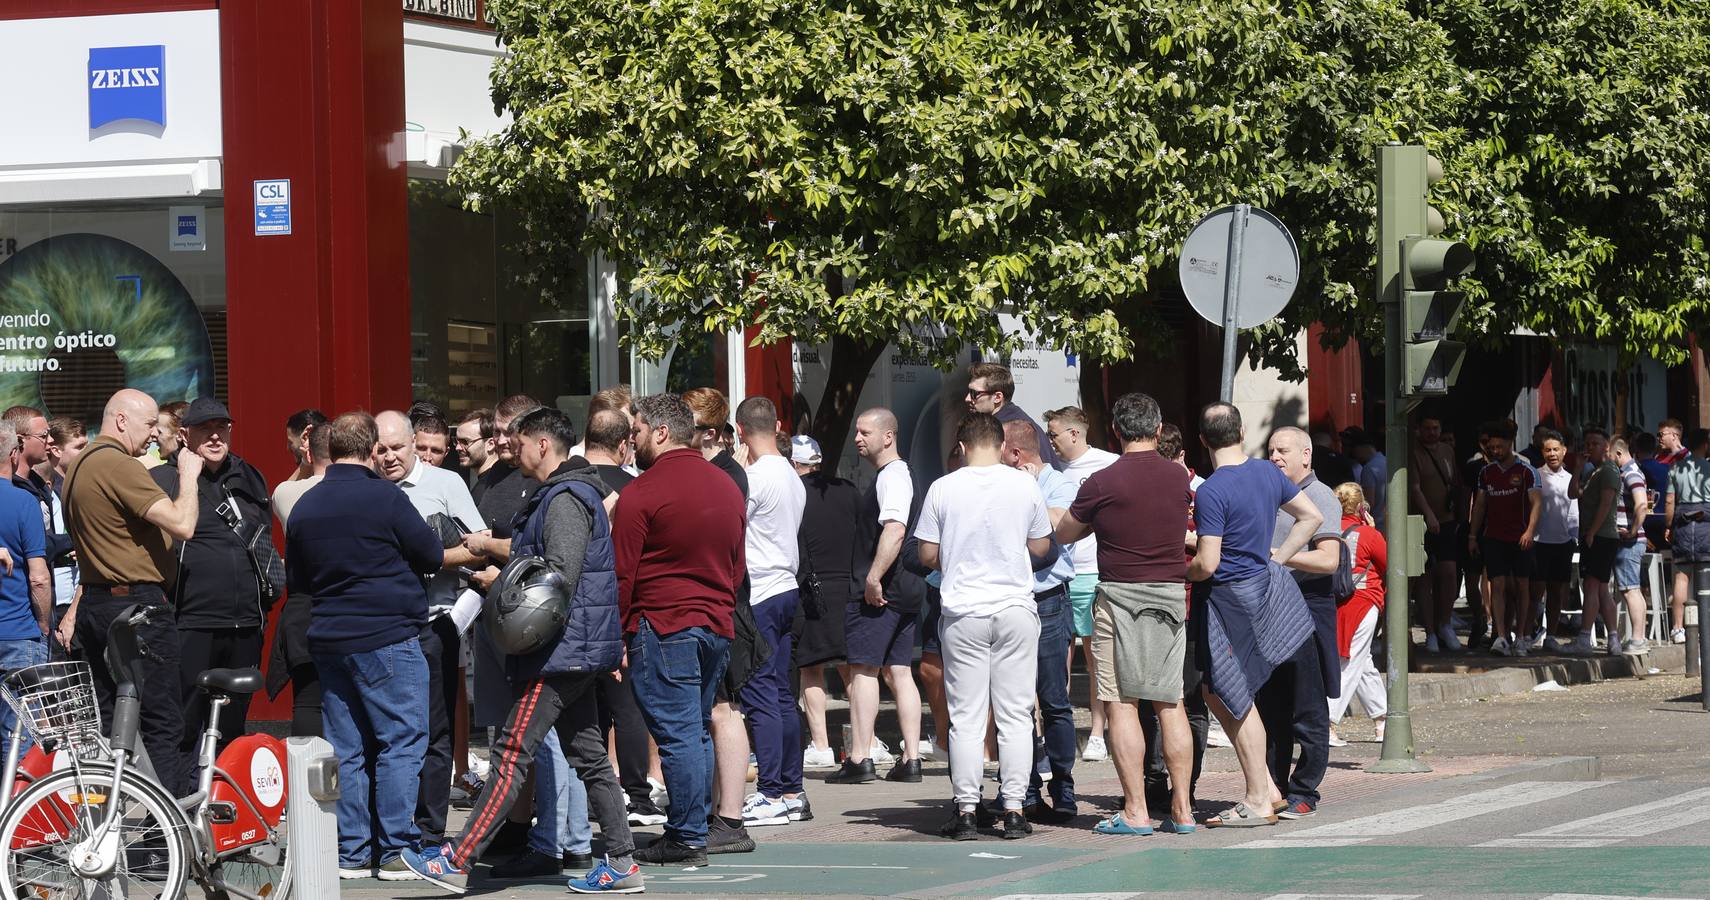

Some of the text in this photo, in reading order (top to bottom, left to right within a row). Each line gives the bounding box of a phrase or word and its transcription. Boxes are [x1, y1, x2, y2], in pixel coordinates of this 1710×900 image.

[92, 67, 159, 88] ZEISS
[260, 185, 284, 198] CSL
[54, 330, 116, 353] óptico
[1012, 356, 1039, 369] necesitas.
